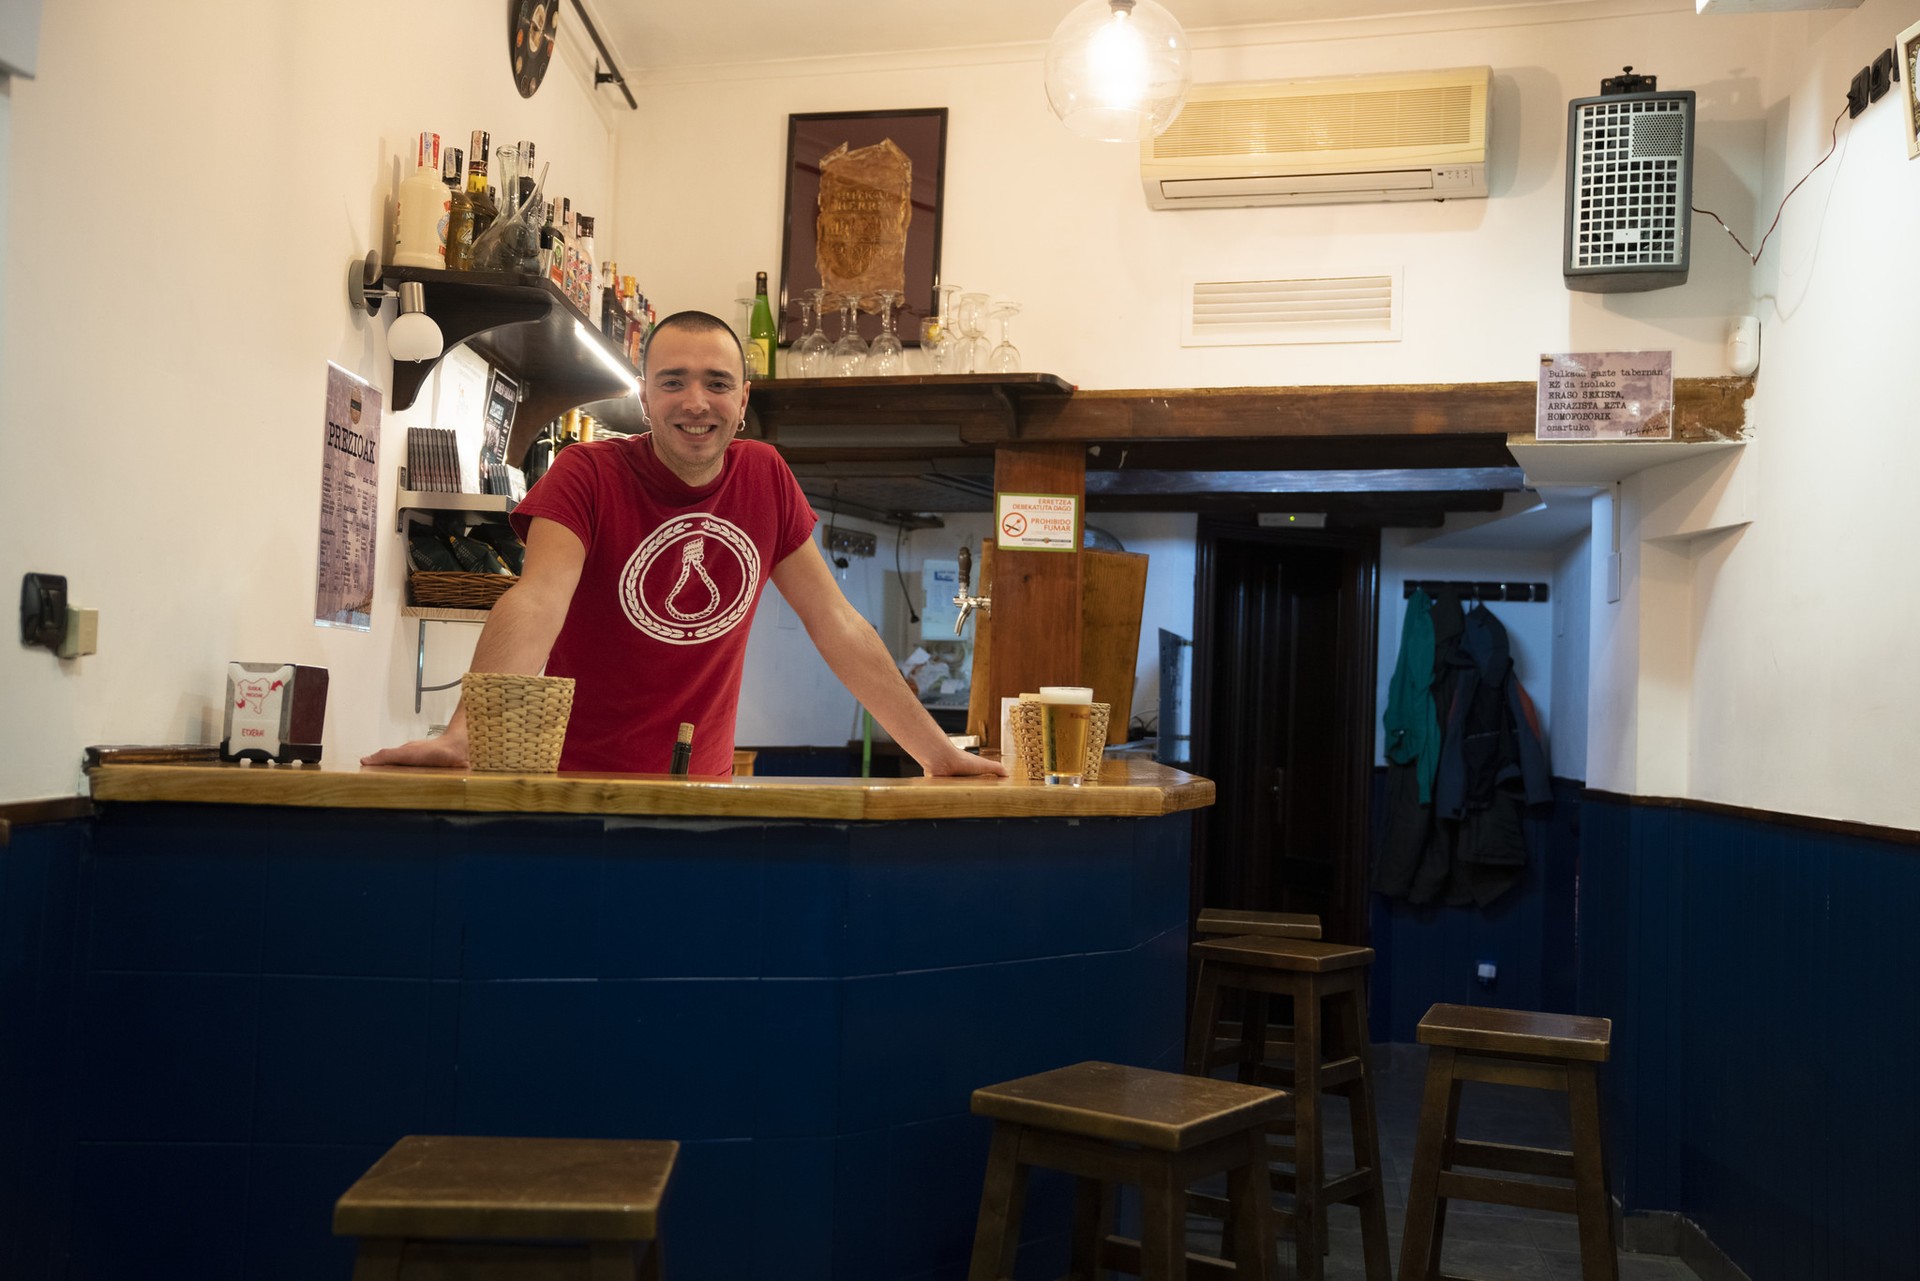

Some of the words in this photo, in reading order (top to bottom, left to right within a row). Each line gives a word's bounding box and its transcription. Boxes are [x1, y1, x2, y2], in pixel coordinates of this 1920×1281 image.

[1590, 370, 1616, 379] gazte
[1621, 368, 1663, 377] tabernan
[1548, 381, 1560, 389] EZ
[1564, 380, 1575, 389] da
[1580, 380, 1616, 388] inolako
[1548, 391, 1578, 400] ERASO
[1582, 390, 1624, 399] SEXISTA,
[1547, 402, 1598, 410] ARRAZISTA
[1604, 401, 1627, 410] EZTA
[1547, 412, 1611, 421] HOMOFOBORIK
[328, 422, 376, 464] PREZIOAK
